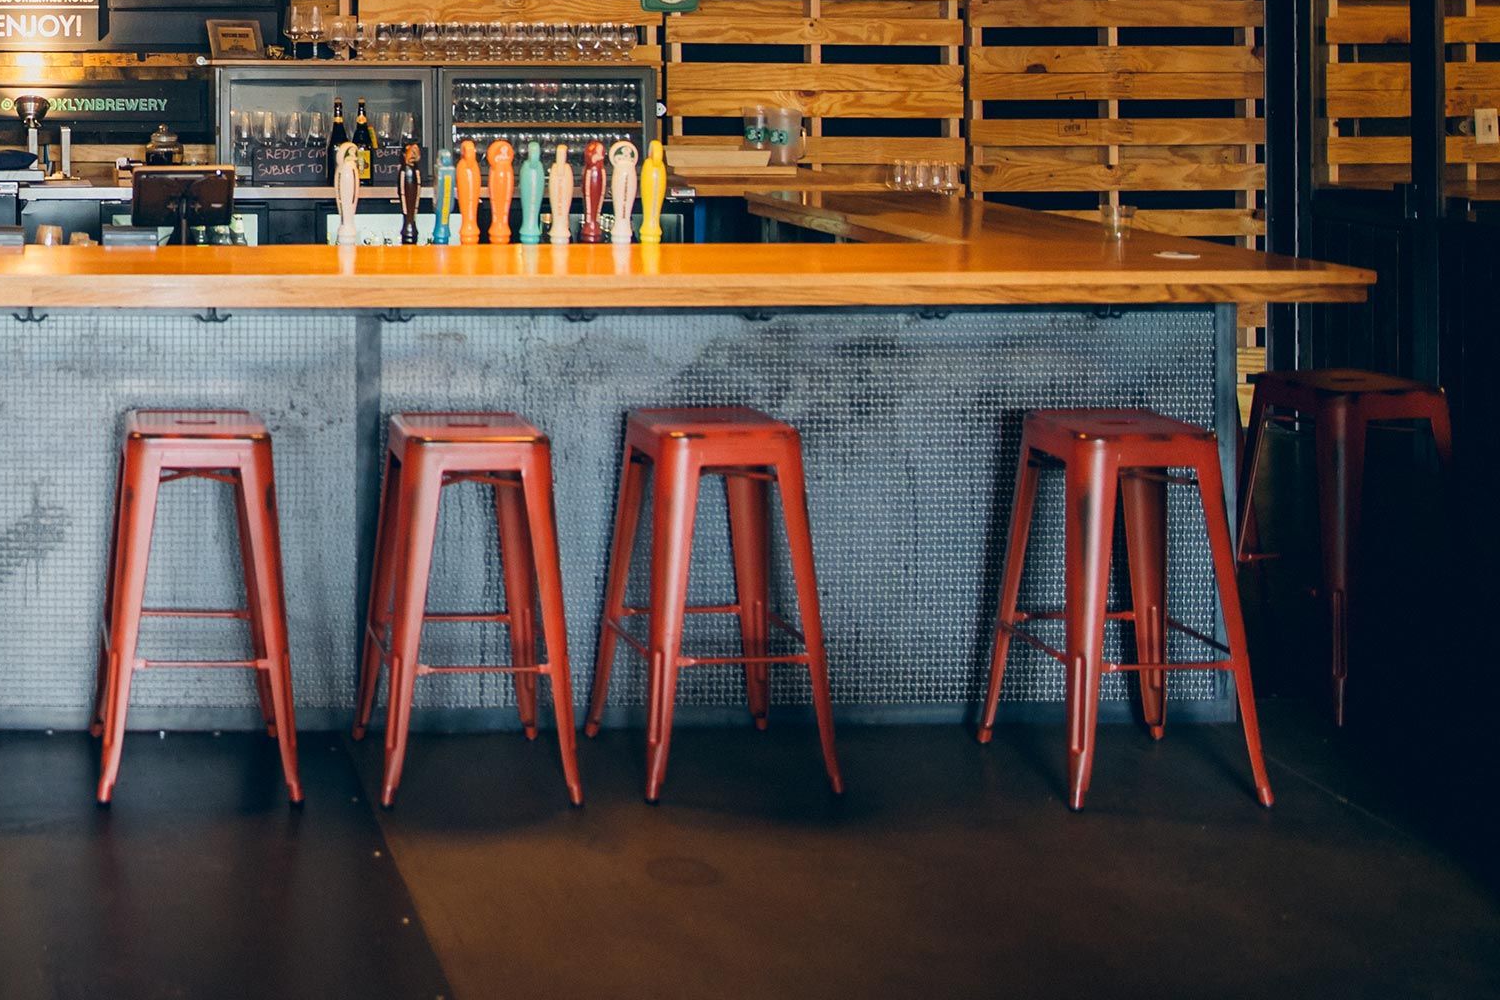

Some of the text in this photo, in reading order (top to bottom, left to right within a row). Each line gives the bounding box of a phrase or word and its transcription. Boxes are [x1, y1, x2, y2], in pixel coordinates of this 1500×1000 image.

[257, 150, 303, 160] CREDIT
[258, 164, 323, 176] SUBJECT TO
